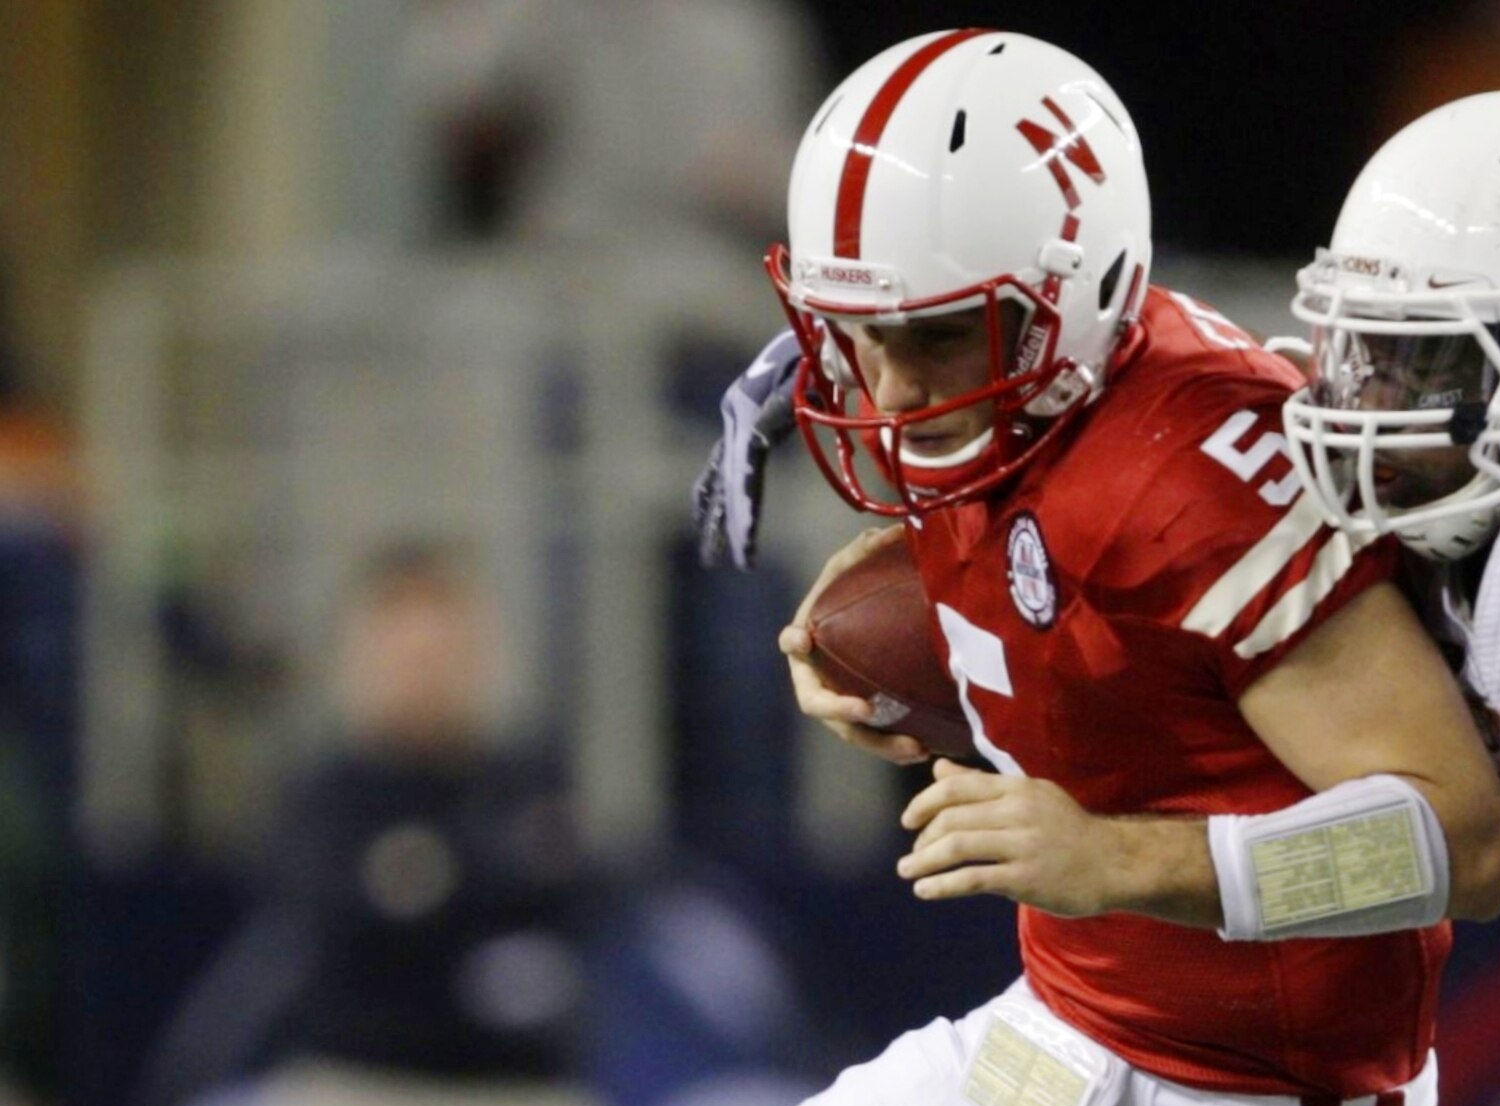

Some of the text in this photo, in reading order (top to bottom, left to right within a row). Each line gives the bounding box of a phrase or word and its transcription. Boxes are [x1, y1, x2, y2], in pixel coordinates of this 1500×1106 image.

[1014, 95, 1106, 211] N
[821, 265, 872, 285] HUSKERS
[1199, 409, 1304, 506] 5
